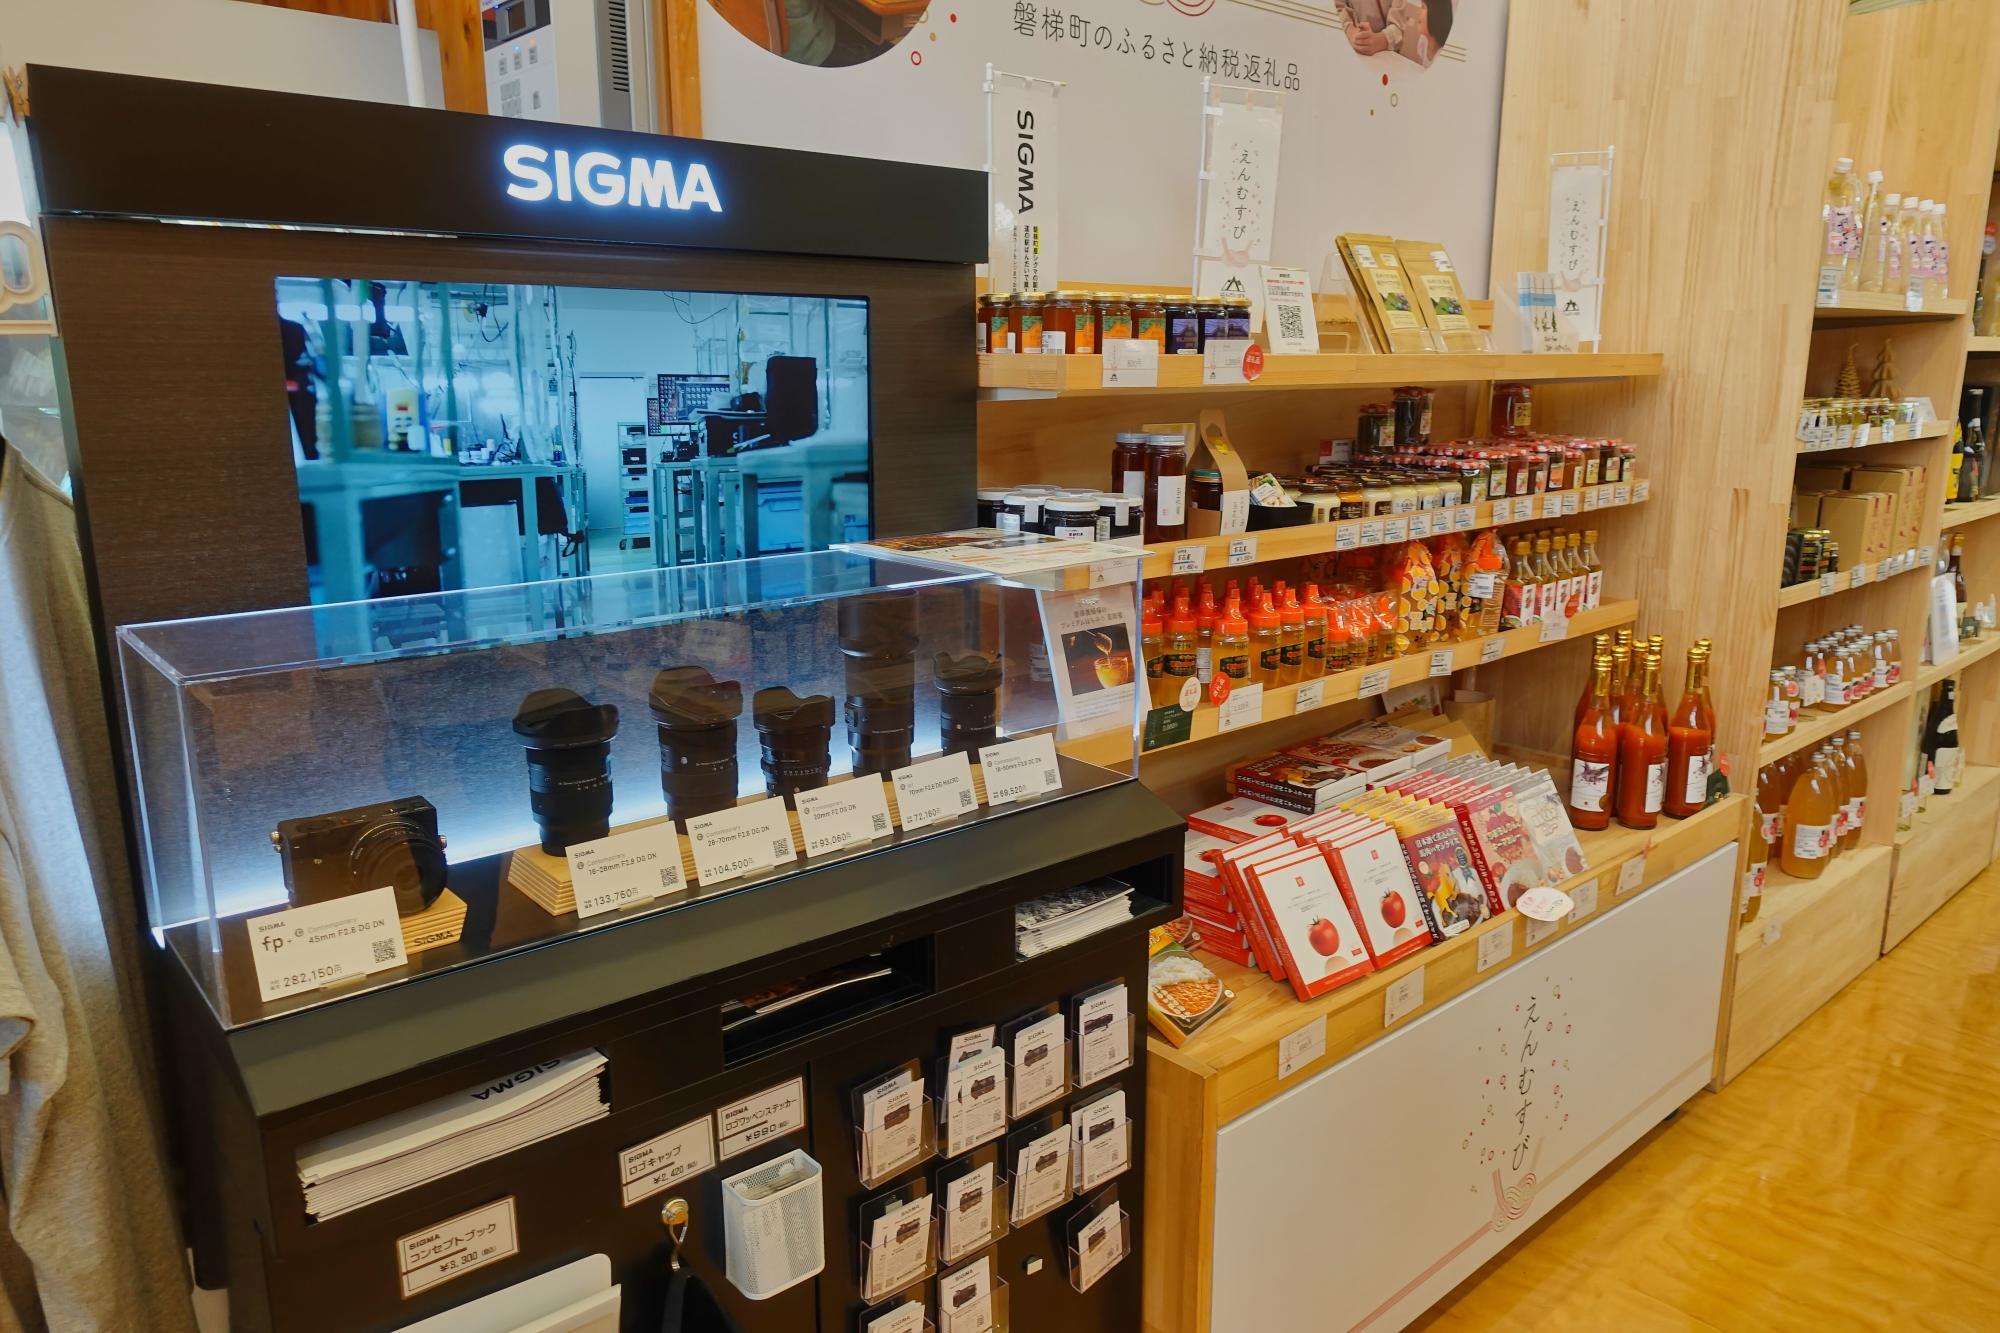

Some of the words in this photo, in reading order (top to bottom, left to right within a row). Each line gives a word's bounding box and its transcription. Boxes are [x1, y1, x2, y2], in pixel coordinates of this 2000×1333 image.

[1013, 0, 1300, 91] 磐梯町のふるさと納税返礼品
[1017, 109, 1034, 214] SIGMA
[504, 144, 723, 212] SIGMA
[1233, 150, 1252, 239] えんむすび
[1568, 200, 1581, 271] えんむすび
[694, 821, 712, 830] SIGMA
[708, 835, 737, 847] 28-70mm
[751, 827, 760, 835] DG
[761, 825, 770, 833] DN
[574, 849, 595, 859] SIGMA
[648, 852, 657, 860] DN
[258, 921, 286, 933] SIGMA
[309, 931, 336, 943] 45mm
[338, 926, 357, 937] F2.8
[358, 922, 371, 932] DG
[373, 918, 385, 929] DN
[262, 935, 284, 952] fp
[413, 929, 454, 947] SIGMA
[1090, 999, 1107, 1009] SIGMA
[963, 1032, 983, 1042] SIGMA
[1027, 1029, 1045, 1041] SIGMA
[973, 1059, 993, 1071] SIGMA
[470, 1058, 561, 1101] SIGMA
[876, 1080, 897, 1096] SIGMA
[1512, 996, 1540, 1171] えんむすび
[887, 1090, 909, 1104] SIGMA
[725, 1106, 749, 1119] SIGMA
[725, 1098, 798, 1131] ロゴワッペンステッカー
[745, 1122, 776, 1142] ¥990
[628, 1148, 654, 1163] SIGMA
[629, 1144, 682, 1176] ロゴキャップ
[962, 1173, 982, 1186] SIGMA
[409, 1233, 441, 1250] SIGMA
[409, 1223, 497, 1263] コンセプトブック
[954, 1268, 974, 1281] SIGMA
[890, 1315, 911, 1328] SIGMA
